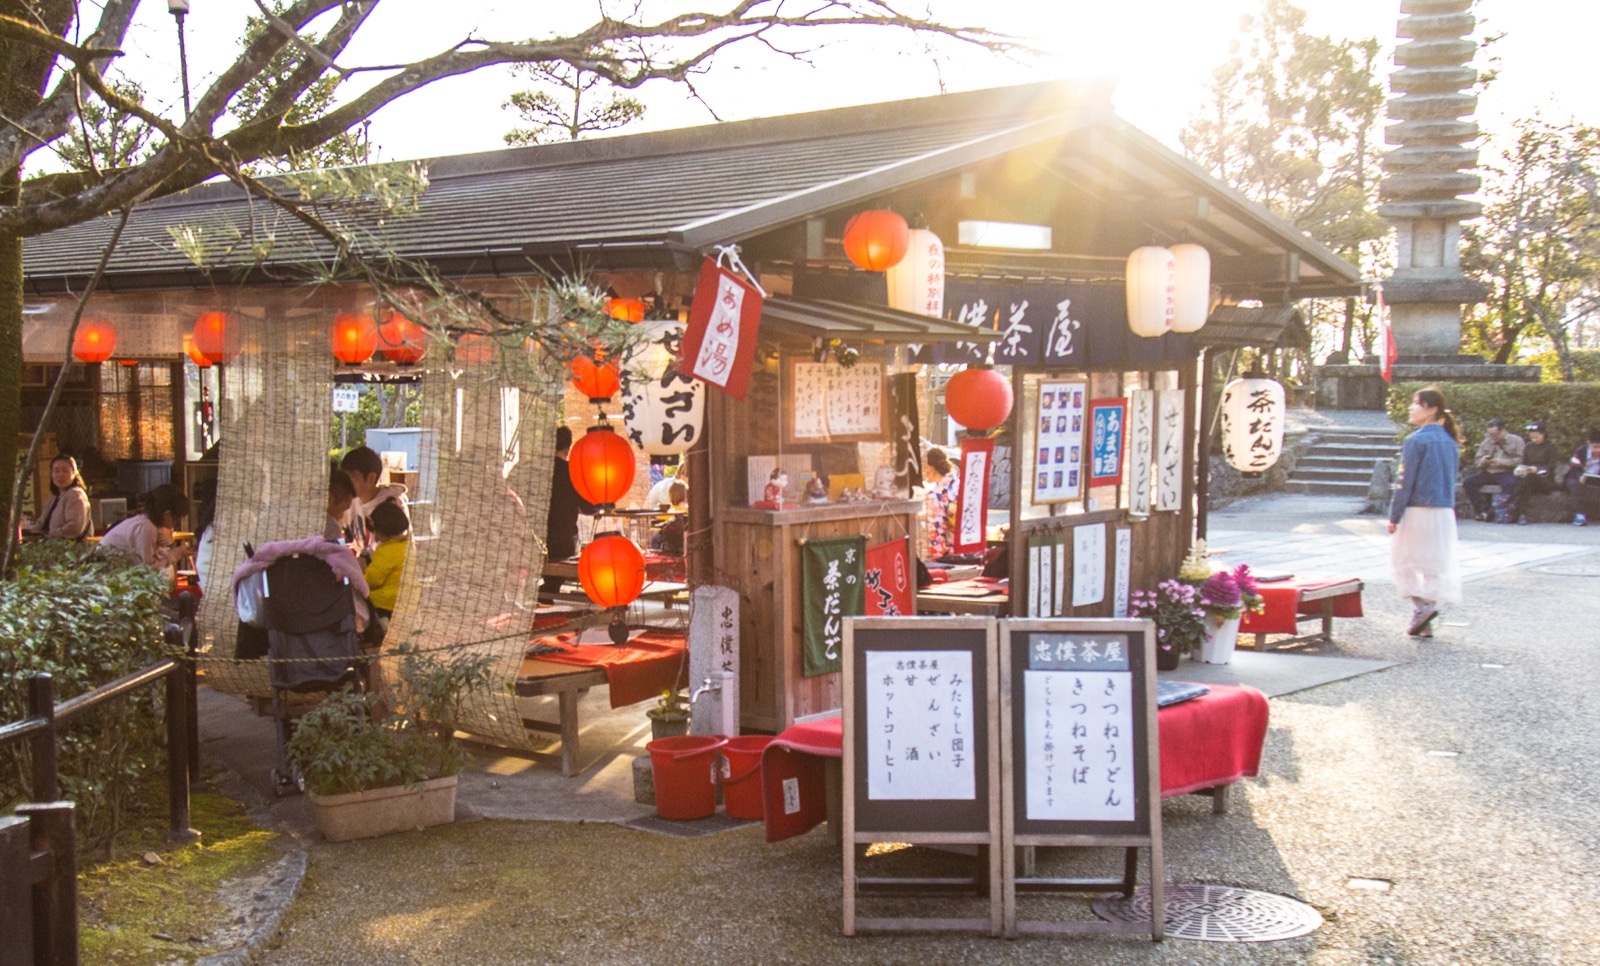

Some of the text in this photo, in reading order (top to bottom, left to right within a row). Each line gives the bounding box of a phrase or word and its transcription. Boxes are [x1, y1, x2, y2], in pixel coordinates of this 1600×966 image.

[926, 243, 942, 318] 夜の特別拝
[701, 286, 736, 376] あめ湯
[1103, 410, 1120, 473] あま酒
[1246, 389, 1276, 467] 茶だんご
[822, 559, 842, 661] 茶だんご
[844, 548, 857, 585] 京の
[1033, 640, 1125, 663] 忠僕茶屋
[882, 674, 895, 784] ホットコーヒー
[927, 673, 941, 761] ぜんざい
[949, 673, 965, 769] みたらし団子
[1070, 677, 1091, 785] きつねそば
[1102, 677, 1122, 806] きつねうどん
